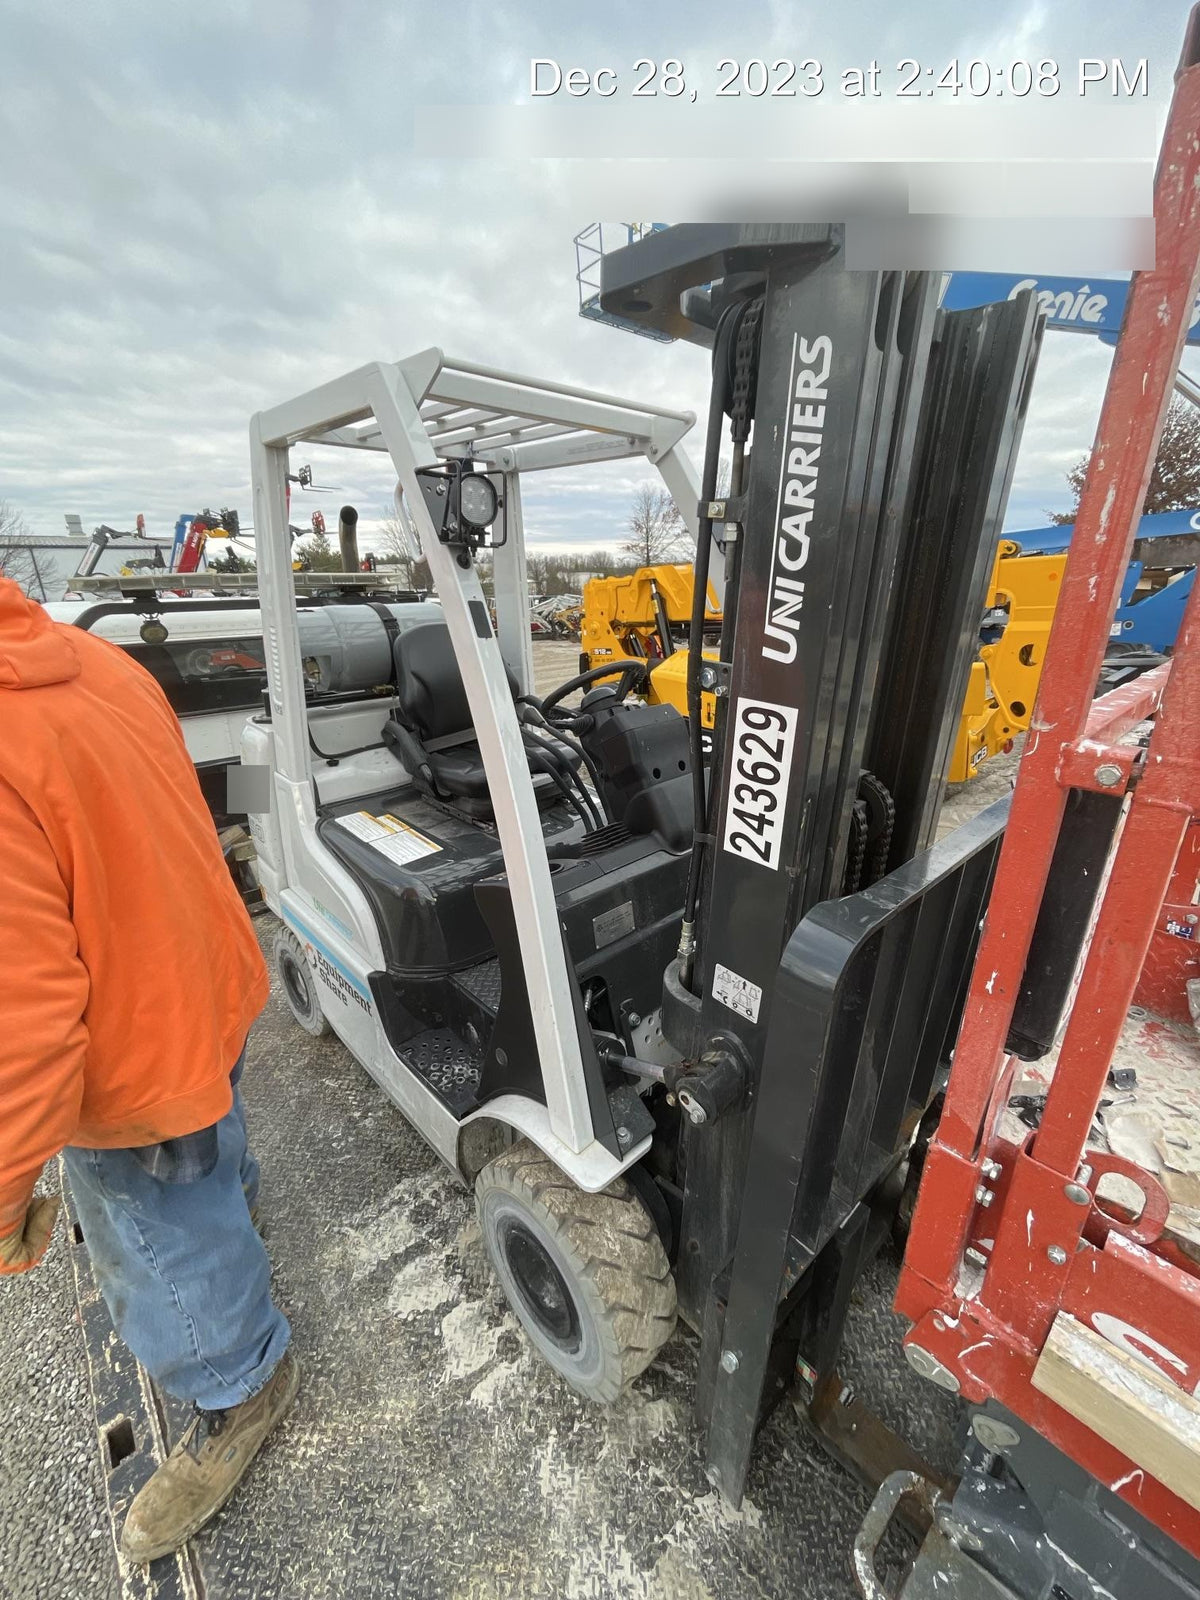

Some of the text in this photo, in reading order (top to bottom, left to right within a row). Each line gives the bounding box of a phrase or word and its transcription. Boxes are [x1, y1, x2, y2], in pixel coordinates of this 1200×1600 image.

[761, 332, 833, 664] UNICARRIERS
[729, 706, 788, 863] 243629
[316, 948, 373, 1017] Equipment
[319, 966, 349, 1007] Share
